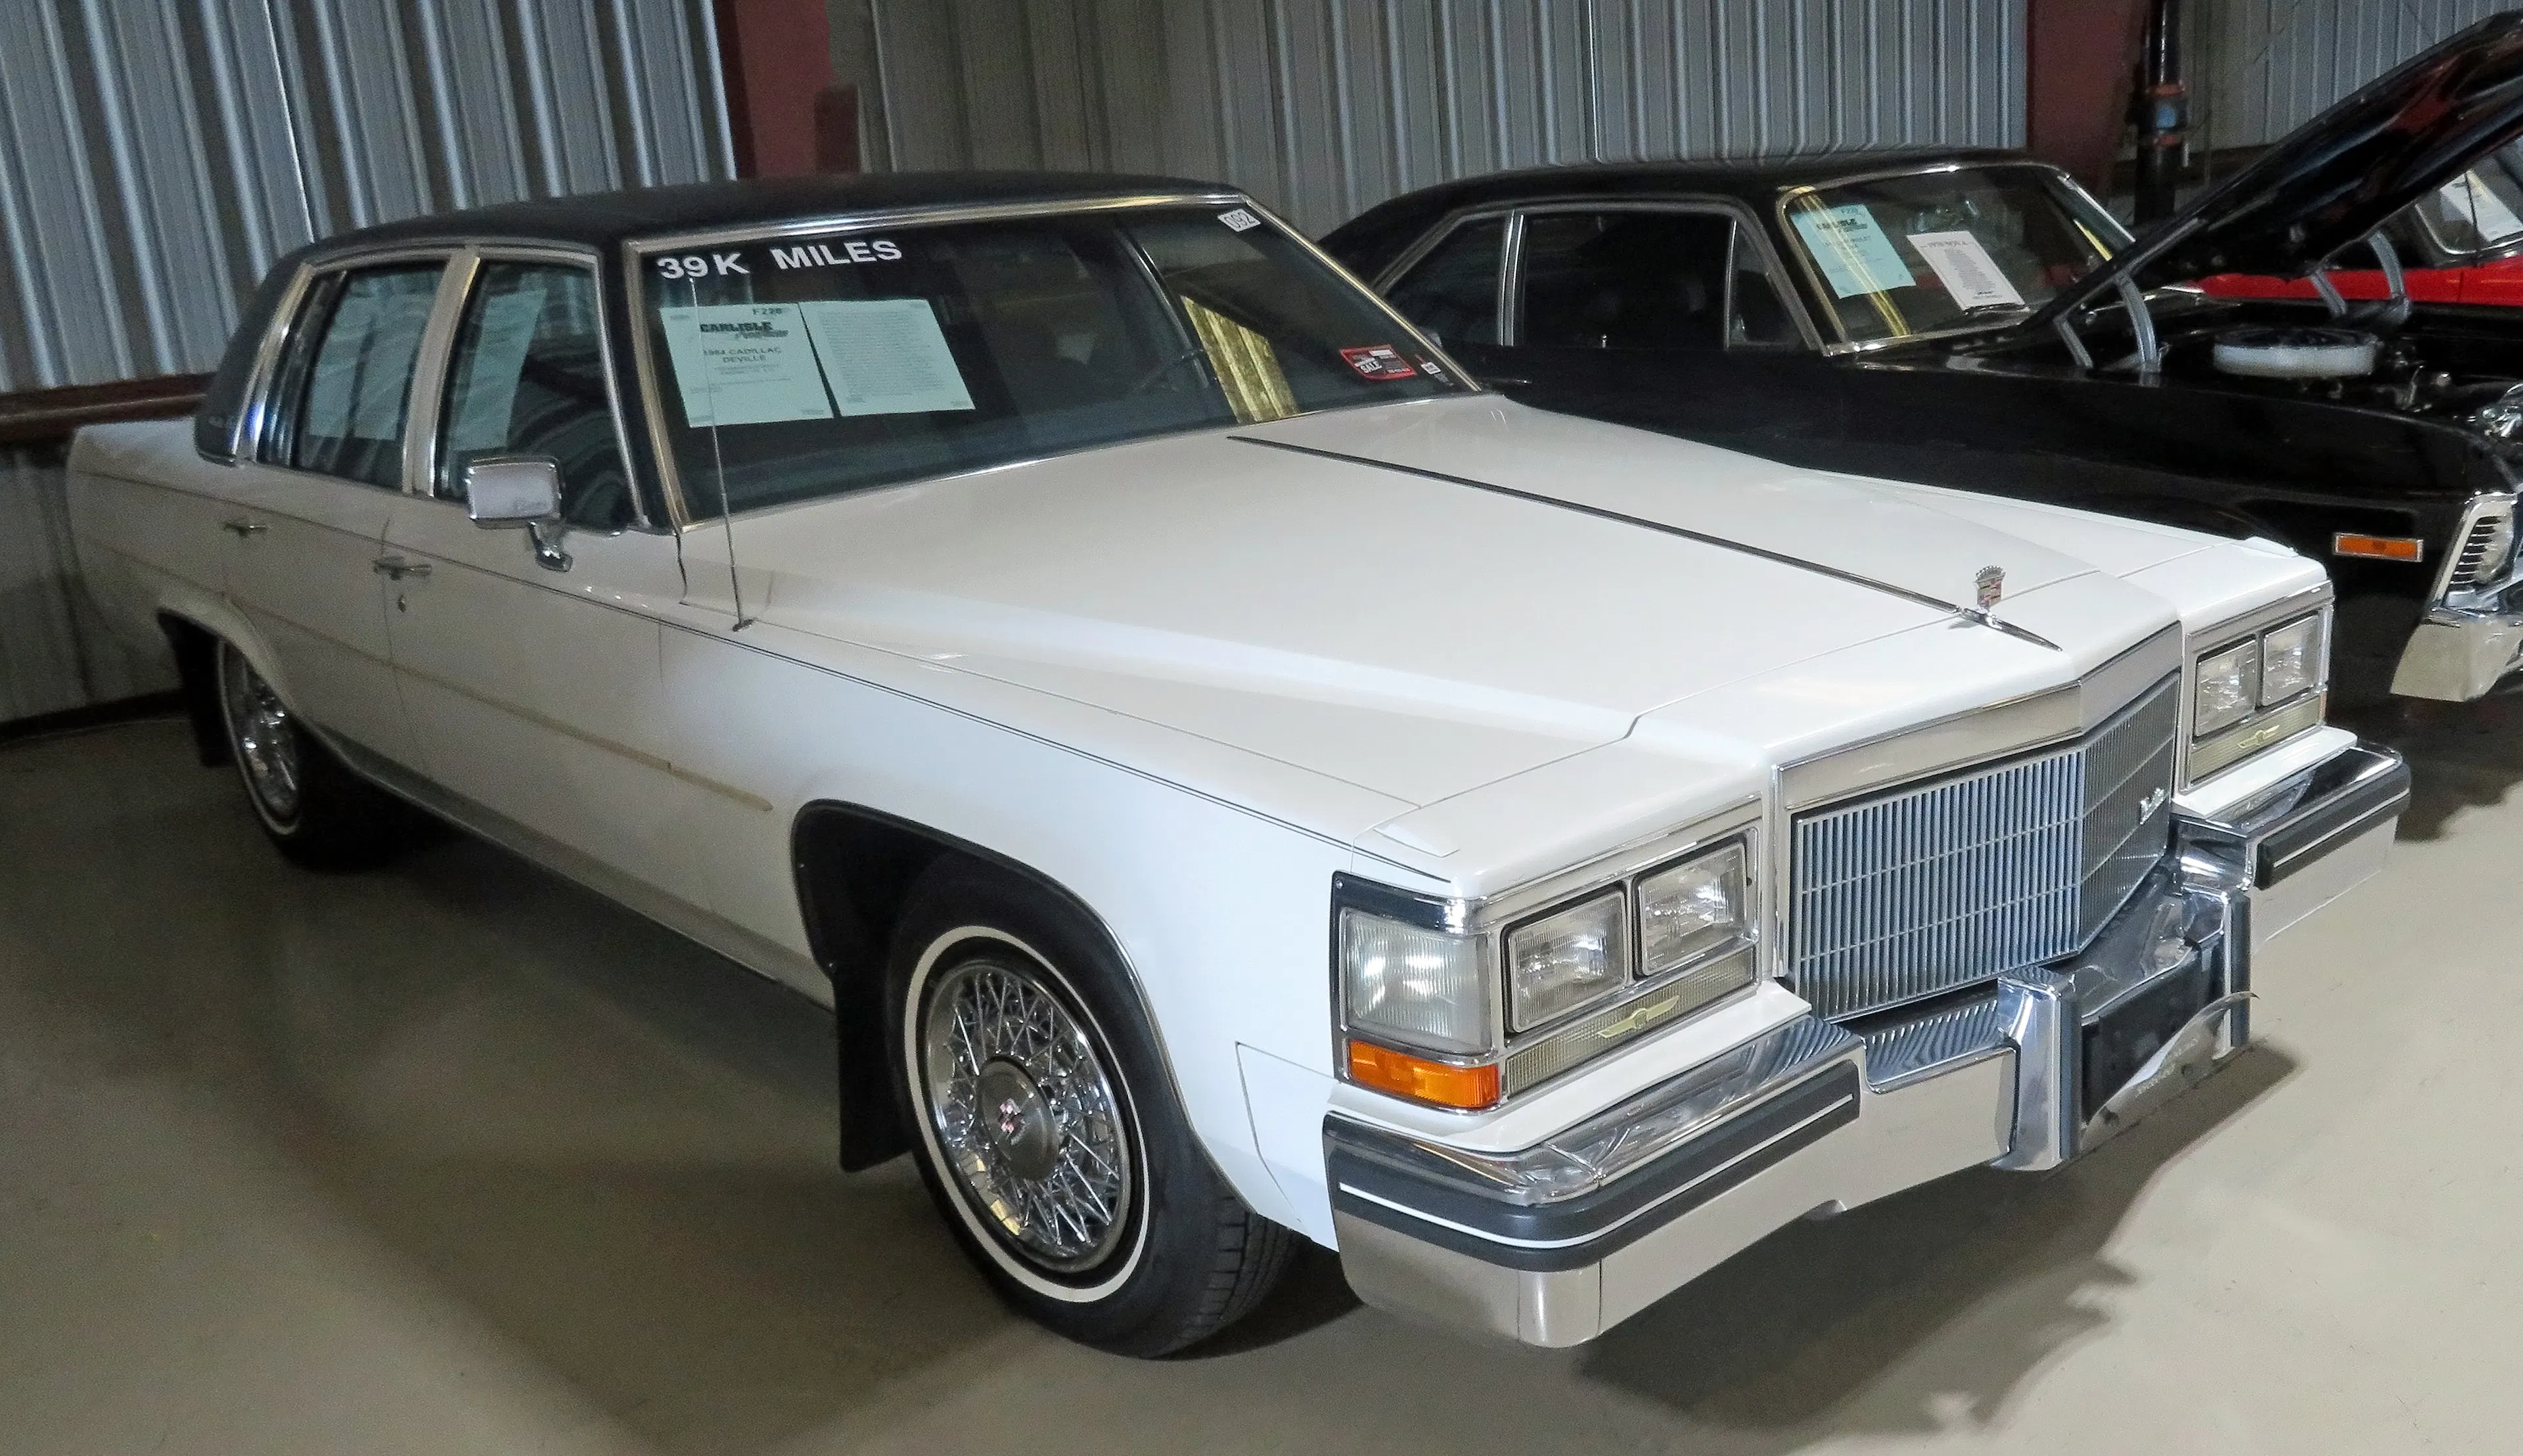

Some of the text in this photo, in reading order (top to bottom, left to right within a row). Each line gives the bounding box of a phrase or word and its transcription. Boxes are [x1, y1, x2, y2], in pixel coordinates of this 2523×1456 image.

[770, 239, 903, 270] MILES
[700, 321, 773, 332] CARLISLE
[729, 347, 782, 355] CADILLAC
[722, 355, 766, 363] DEVILLE
[1360, 361, 1382, 374] SALE
